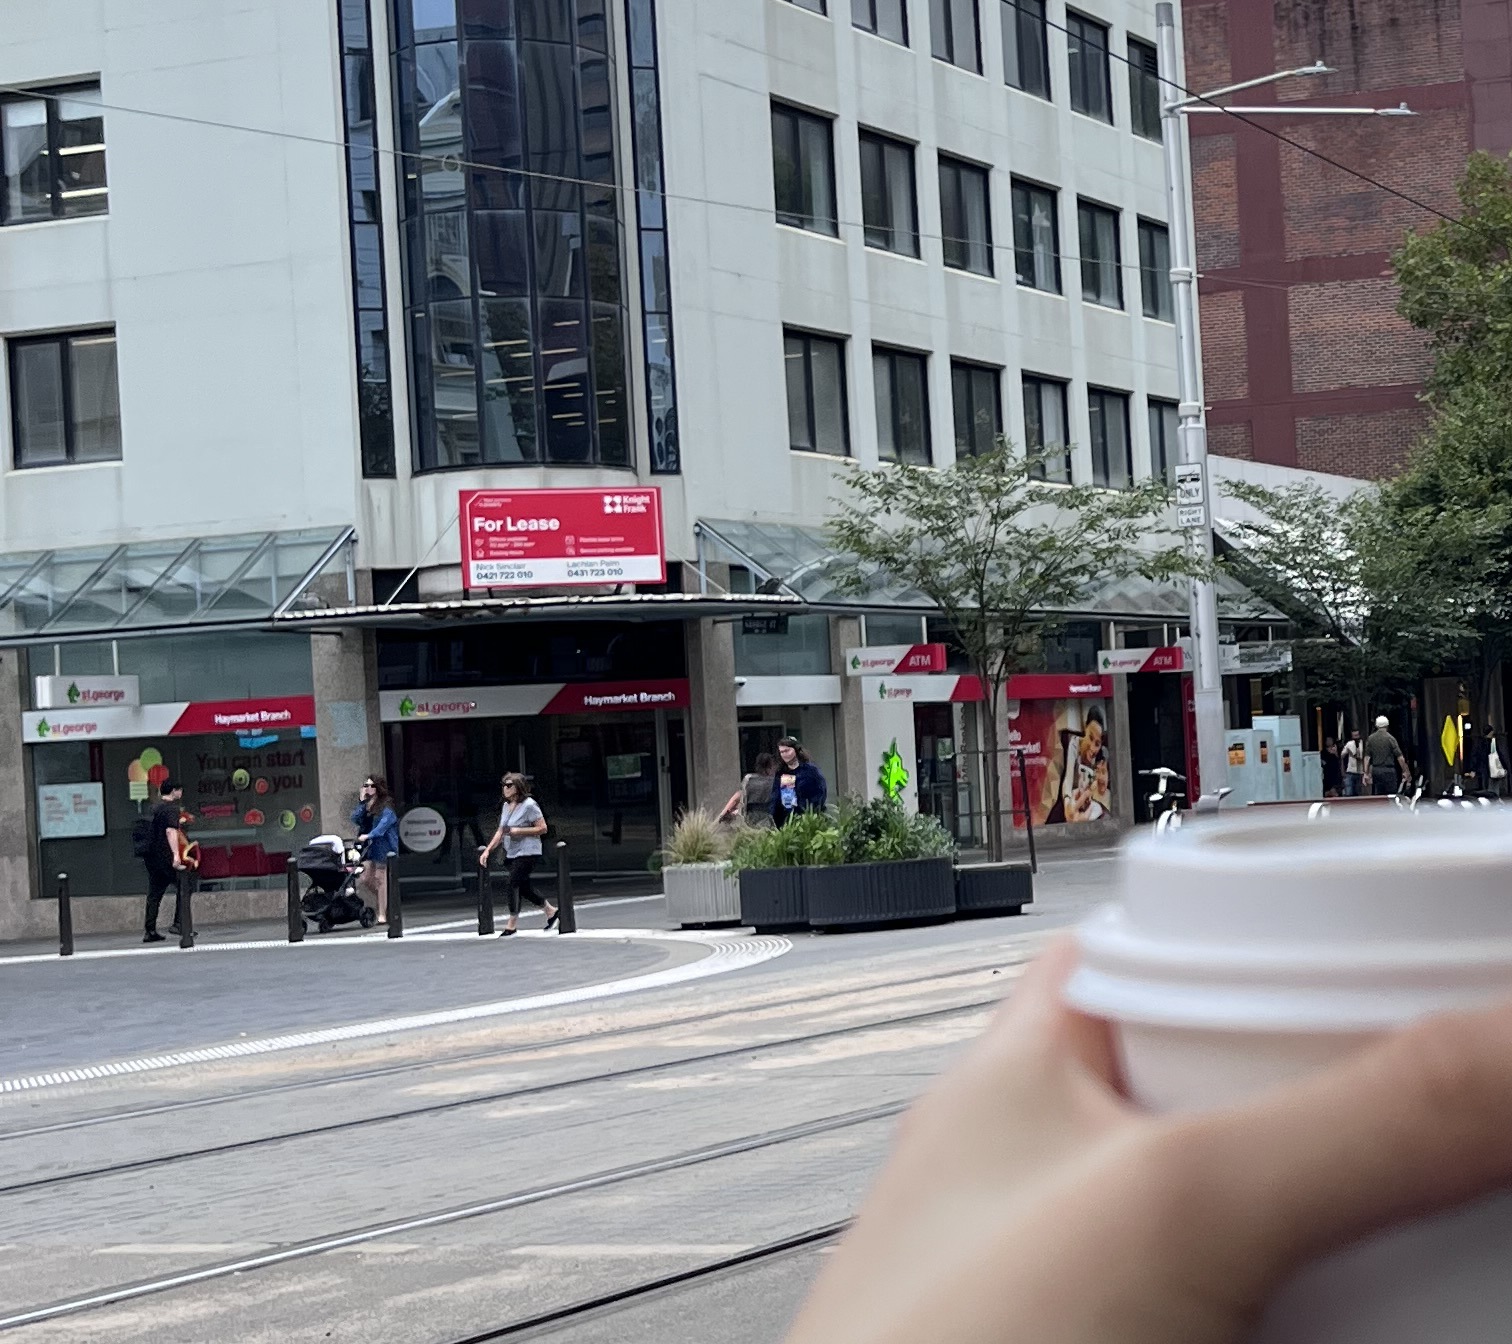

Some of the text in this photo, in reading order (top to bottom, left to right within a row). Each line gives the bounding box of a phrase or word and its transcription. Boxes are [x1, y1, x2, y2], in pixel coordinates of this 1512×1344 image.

[473, 516, 560, 532] For Lease
[909, 655, 931, 666] ATM
[1153, 656, 1173, 666] ATM
[584, 692, 676, 706] Haymarket Branch
[214, 709, 291, 726] Haymarket Branch
[196, 749, 306, 770] You can start
[272, 773, 304, 794] you
